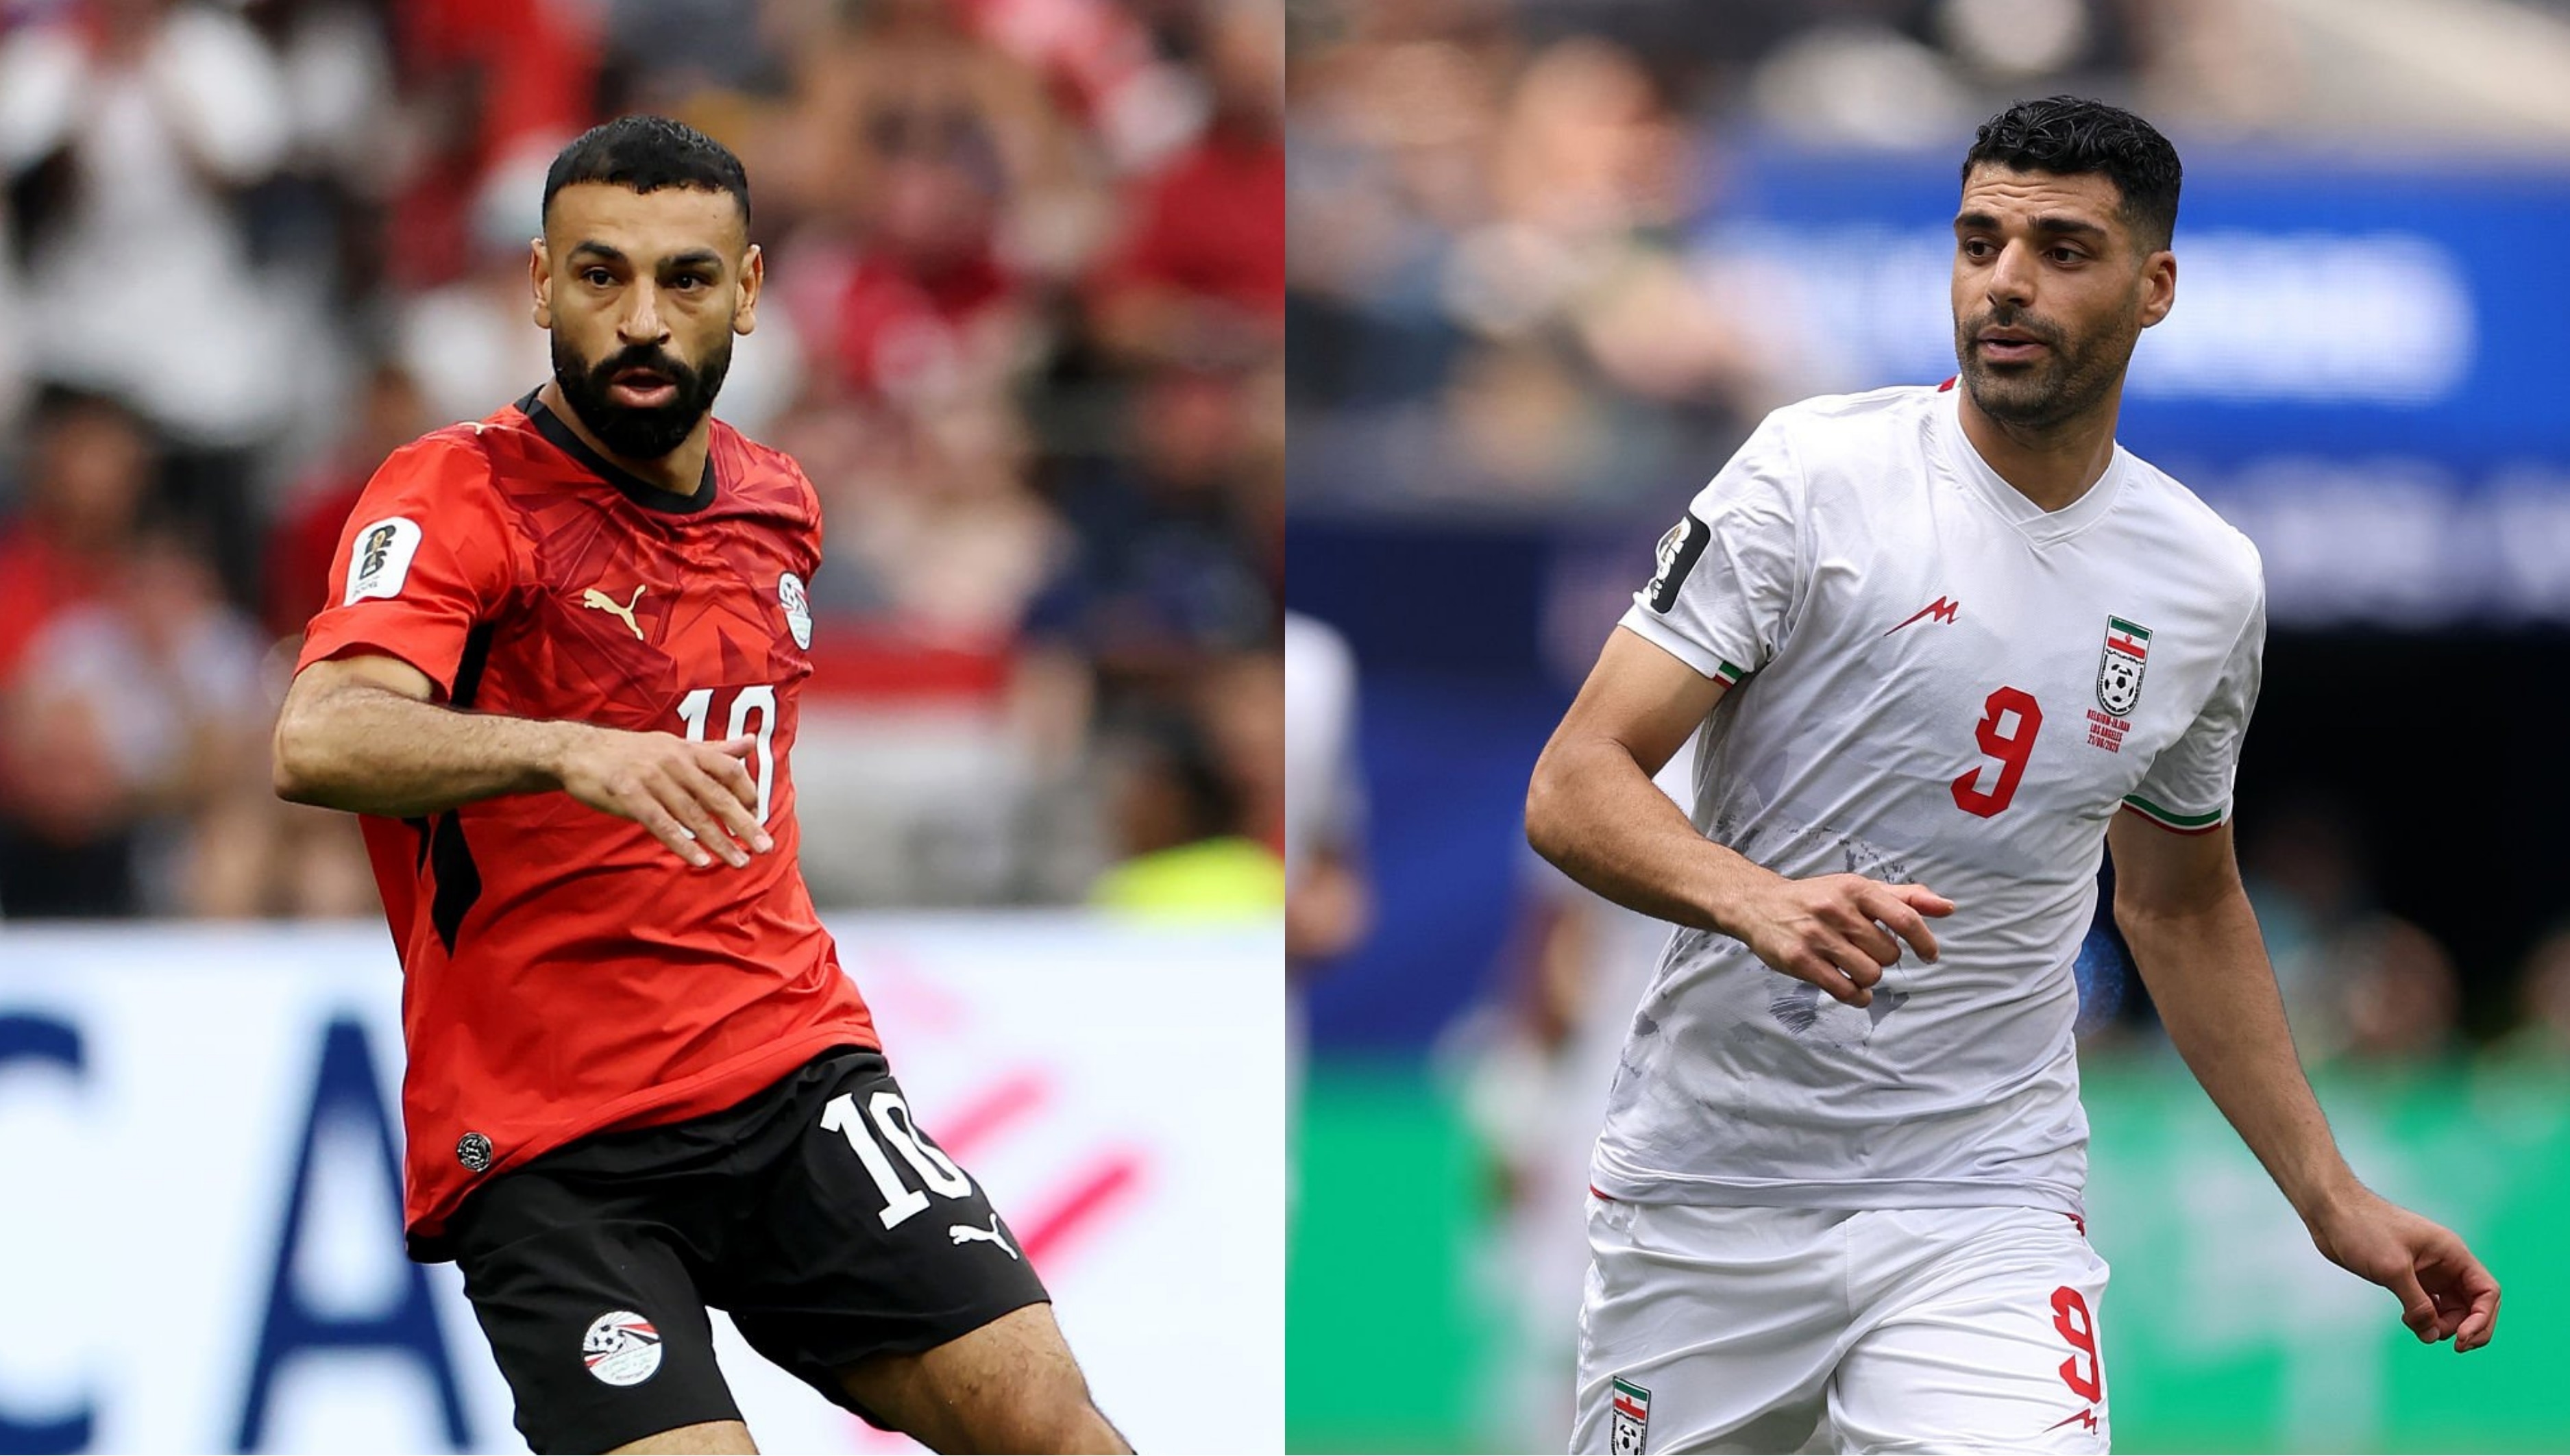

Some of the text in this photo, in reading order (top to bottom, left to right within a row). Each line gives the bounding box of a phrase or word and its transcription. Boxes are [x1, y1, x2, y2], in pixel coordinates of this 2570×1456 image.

[1950, 686, 2043, 818] 9
[2090, 722, 2122, 742] LOS ANGELES
[820, 1092, 972, 1230] 10
[2051, 1286, 2102, 1404] 9
